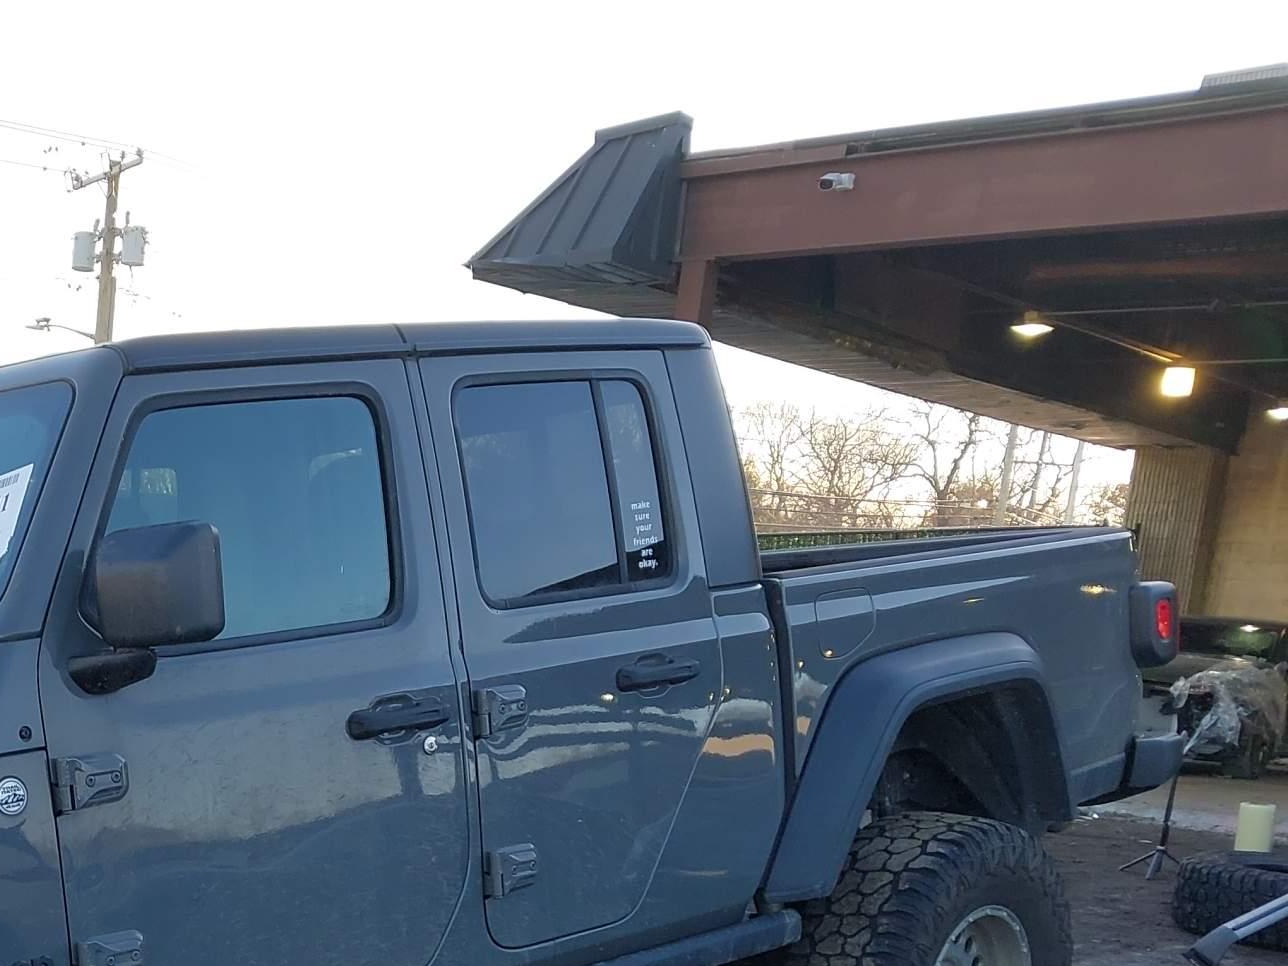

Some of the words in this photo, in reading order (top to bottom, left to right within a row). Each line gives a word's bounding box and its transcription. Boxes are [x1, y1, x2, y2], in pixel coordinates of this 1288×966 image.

[631, 500, 650, 510] make
[634, 512, 650, 521] sure
[635, 523, 652, 535] your
[633, 536, 658, 546] friends
[641, 548, 653, 557] are
[638, 559, 659, 569] okay.
